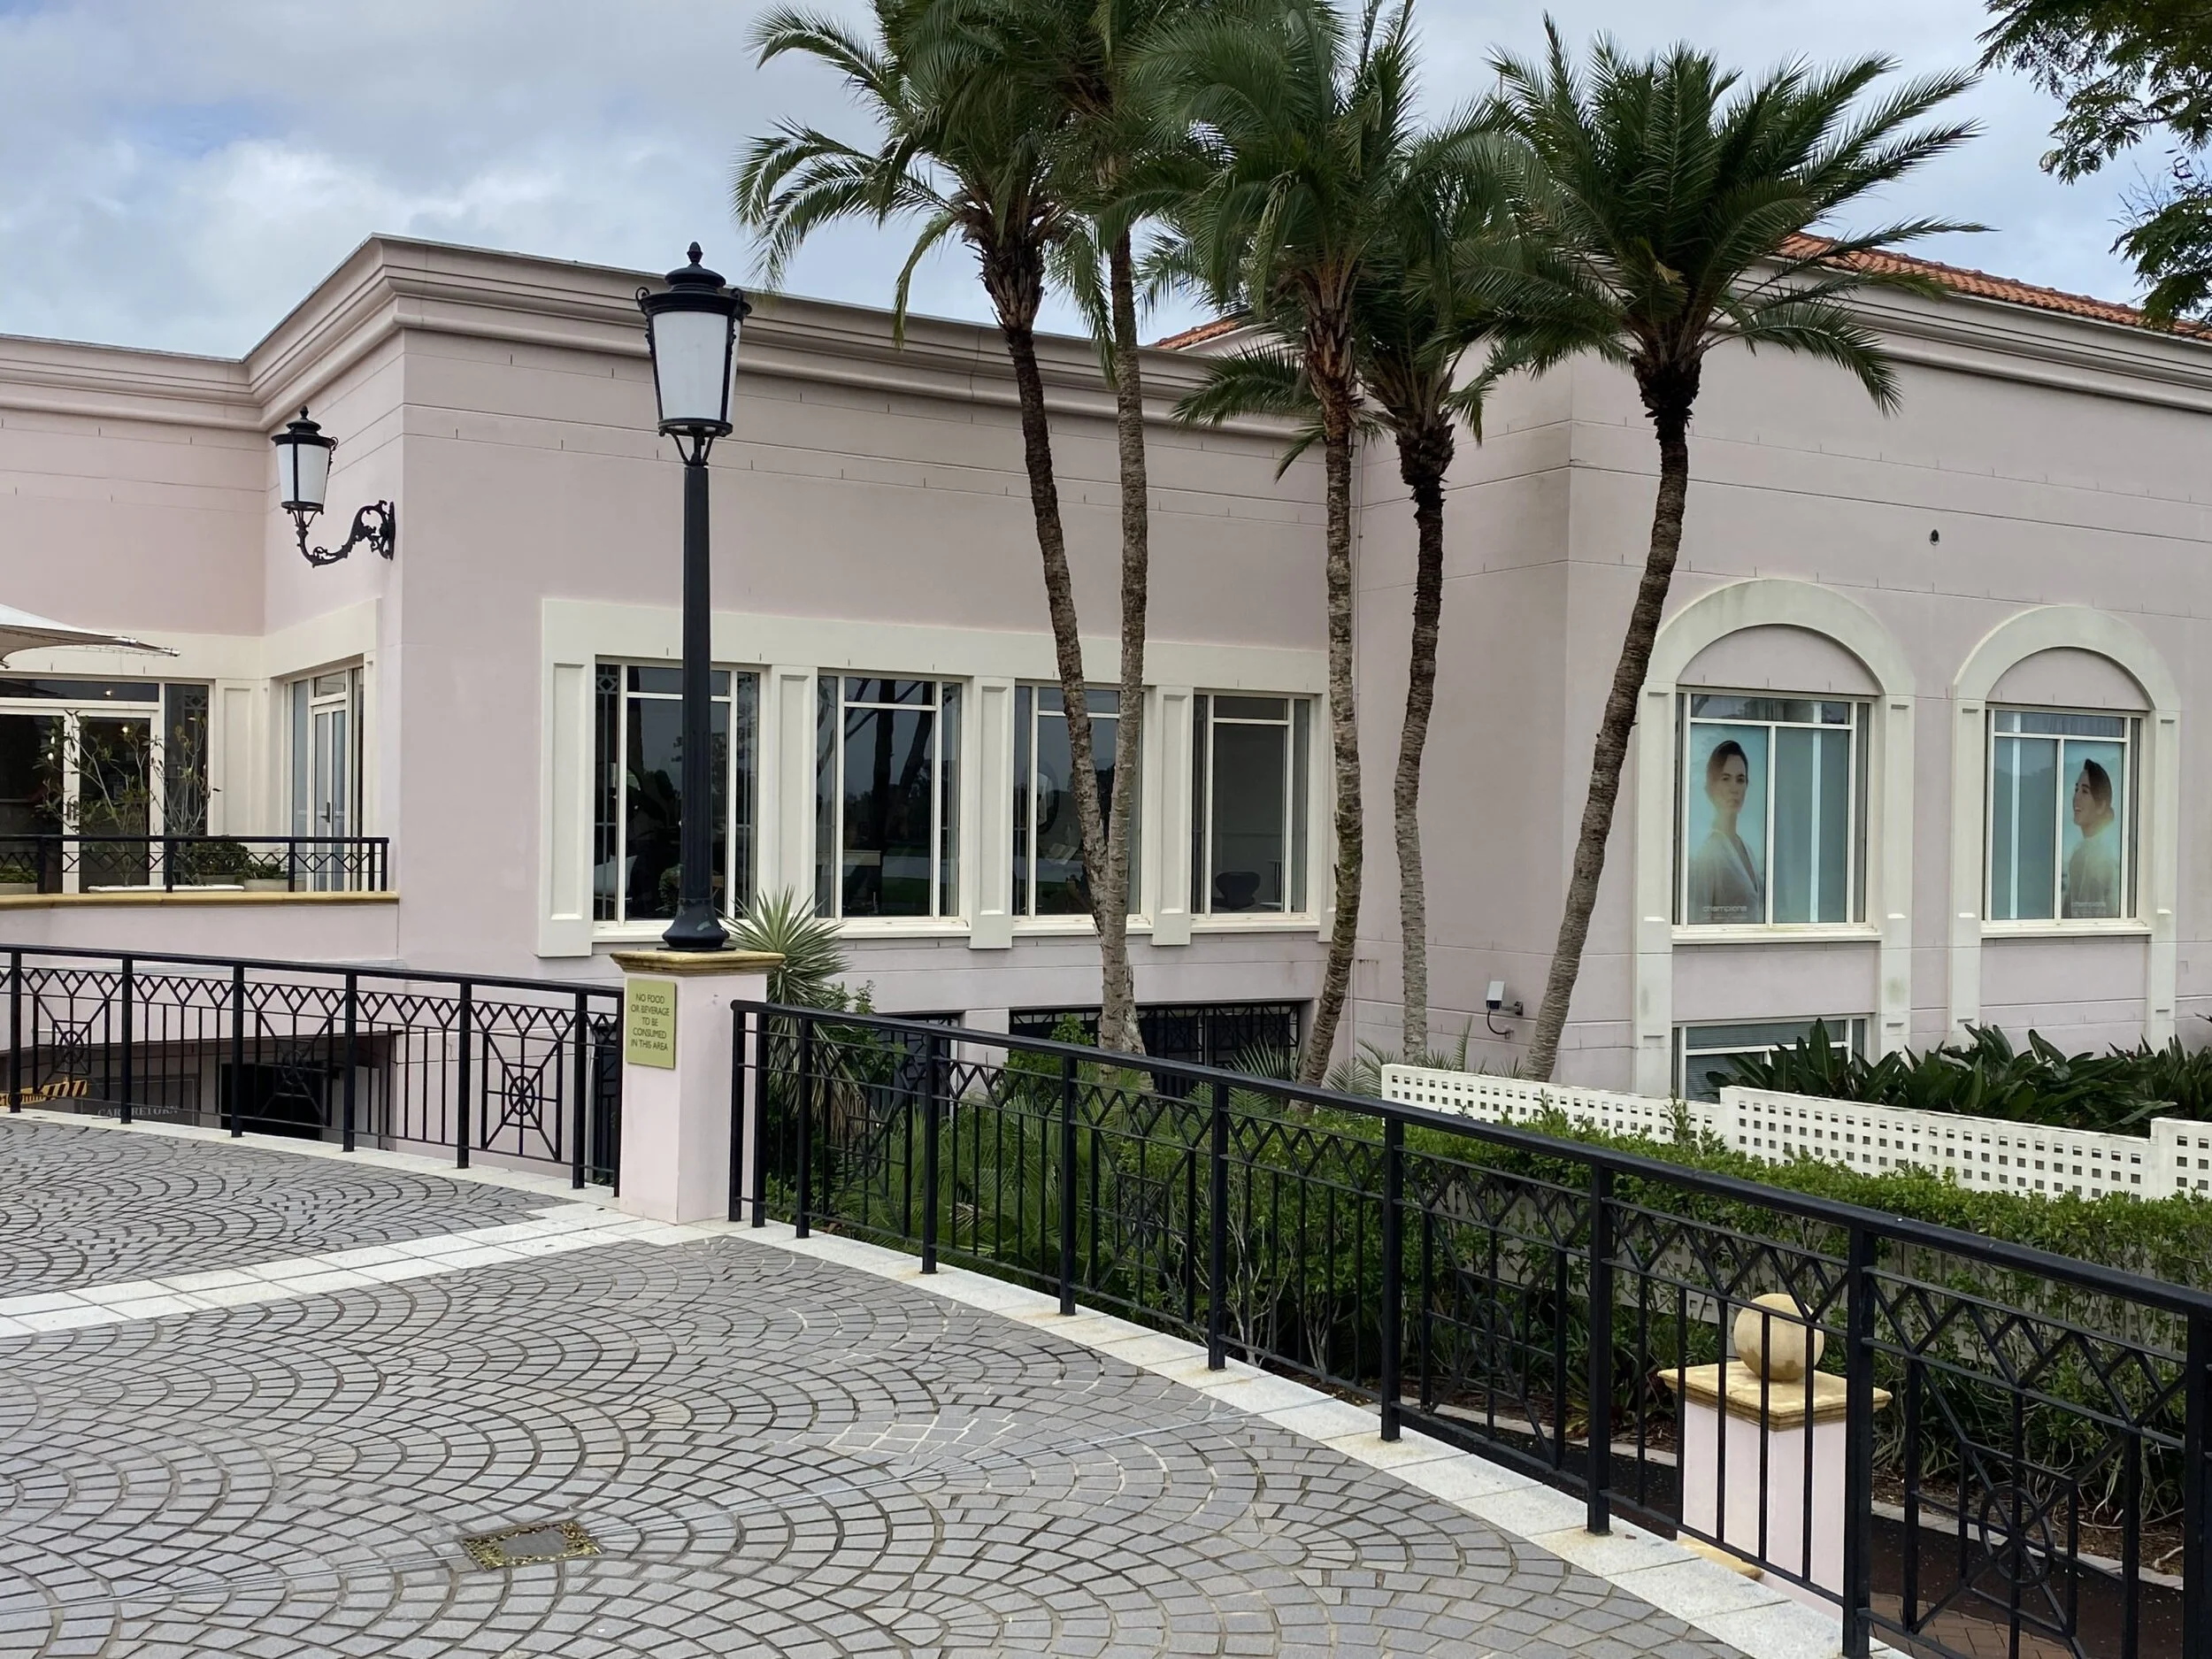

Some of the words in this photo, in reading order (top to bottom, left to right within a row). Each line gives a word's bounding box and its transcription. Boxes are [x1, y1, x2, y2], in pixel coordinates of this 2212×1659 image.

[636, 993, 646, 1002] NO
[648, 995, 665, 1004] FOOD
[641, 1005, 670, 1016] BEVERAGE
[642, 1017, 650, 1025] TO
[633, 1027, 666, 1039] CONSUMED
[640, 1040, 651, 1048] THIS
[652, 1041, 668, 1051] AREA
[0, 1094, 43, 1106] 1mm
